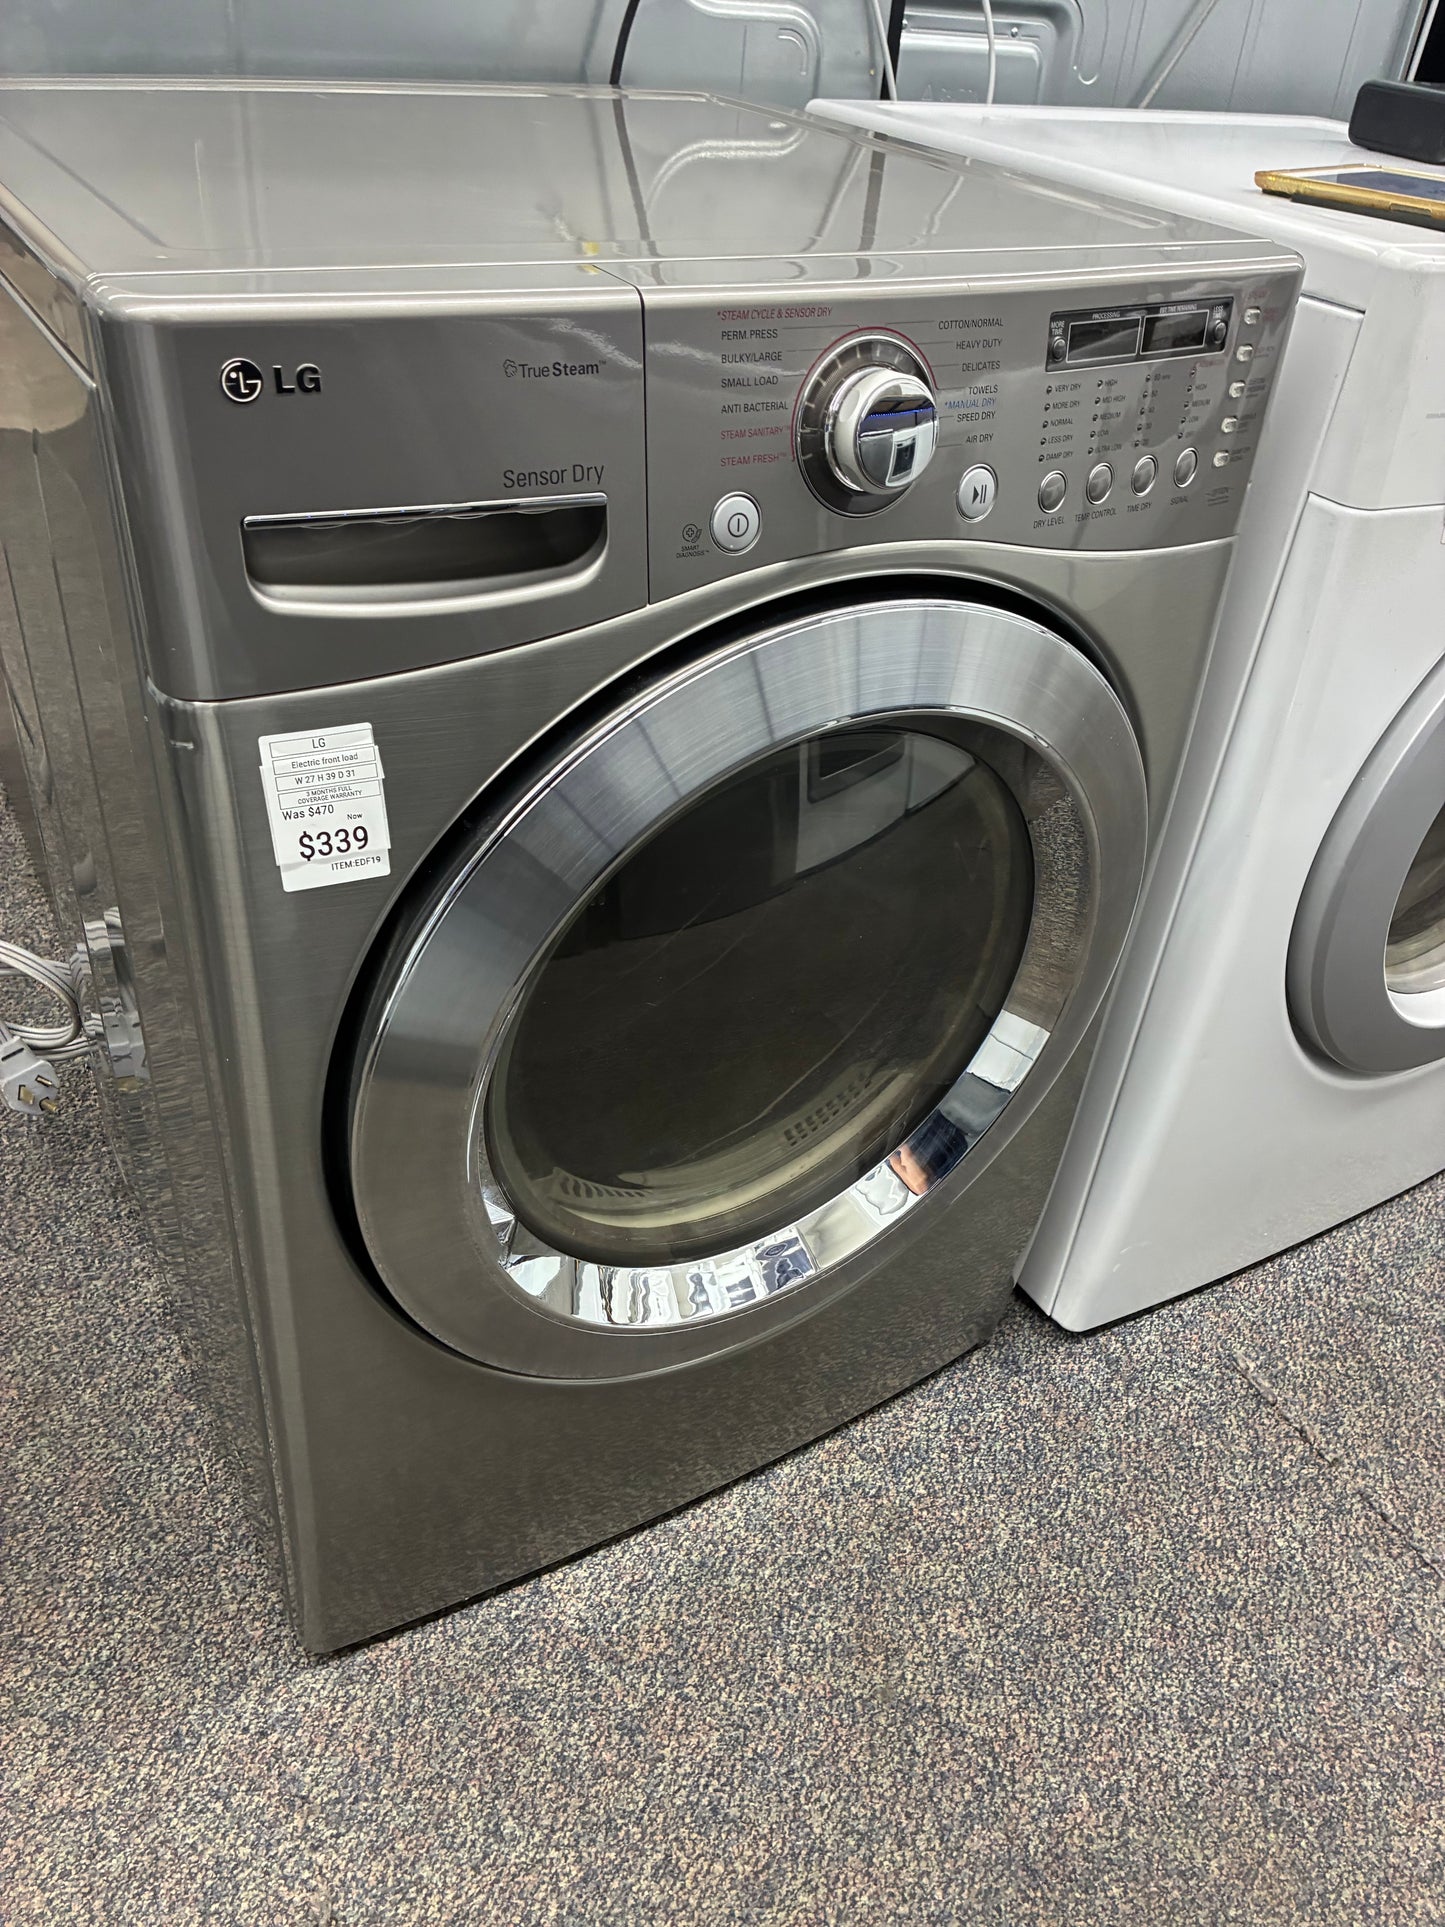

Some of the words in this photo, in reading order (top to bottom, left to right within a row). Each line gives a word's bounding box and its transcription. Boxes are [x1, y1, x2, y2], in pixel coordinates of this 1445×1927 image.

[750, 308, 776, 320] CYCLE
[776, 308, 783, 319] &
[784, 307, 816, 319] SENSOR
[816, 306, 833, 317] DRY
[750, 328, 779, 339] PRESS
[956, 340, 981, 350] HEAVY
[982, 338, 1003, 348] DUTY
[721, 351, 783, 364] BULKY/LARGE
[961, 360, 1001, 372] DELICATES
[272, 363, 321, 394] LG
[721, 377, 751, 389] SMALL
[754, 375, 779, 386] LOAD
[968, 384, 999, 395] TOWELS
[1054, 384, 1069, 392] VERY
[1070, 383, 1081, 391] DRY
[720, 403, 742, 415] ANTI
[743, 400, 789, 413] BACTERIAL
[981, 397, 997, 407] DRY
[1052, 401, 1068, 409] MORE
[1069, 400, 1080, 408] DRY
[957, 412, 980, 423] SPEED
[981, 411, 996, 421] DRY
[720, 428, 747, 440] STEAM
[965, 434, 978, 444] AIR
[979, 433, 994, 442] DRY
[720, 455, 751, 467] STEAM
[503, 468, 567, 488] Sensor
[572, 464, 604, 485] Dry
[1140, 502, 1153, 512] DRY
[1033, 519, 1046, 529] DRY
[1047, 516, 1065, 527] LEVEL
[312, 737, 326, 749] LG
[291, 757, 321, 769] Electric
[322, 754, 340, 765] front
[341, 752, 359, 762] load
[294, 777, 303, 785] W
[305, 775, 315, 784] 27
[317, 774, 324, 782] H
[326, 772, 336, 781] 39
[337, 771, 344, 779] D
[345, 769, 356, 778] 31
[310, 788, 337, 796] MONTHS
[337, 785, 353, 793] FULL
[297, 795, 328, 805] COVERAGE
[329, 789, 362, 800] WARRANTY
[281, 809, 306, 821] Was
[308, 804, 335, 818] $470
[346, 812, 363, 821] Now
[299, 825, 369, 862] $339
[331, 855, 381, 871] ITEM:EDF19
